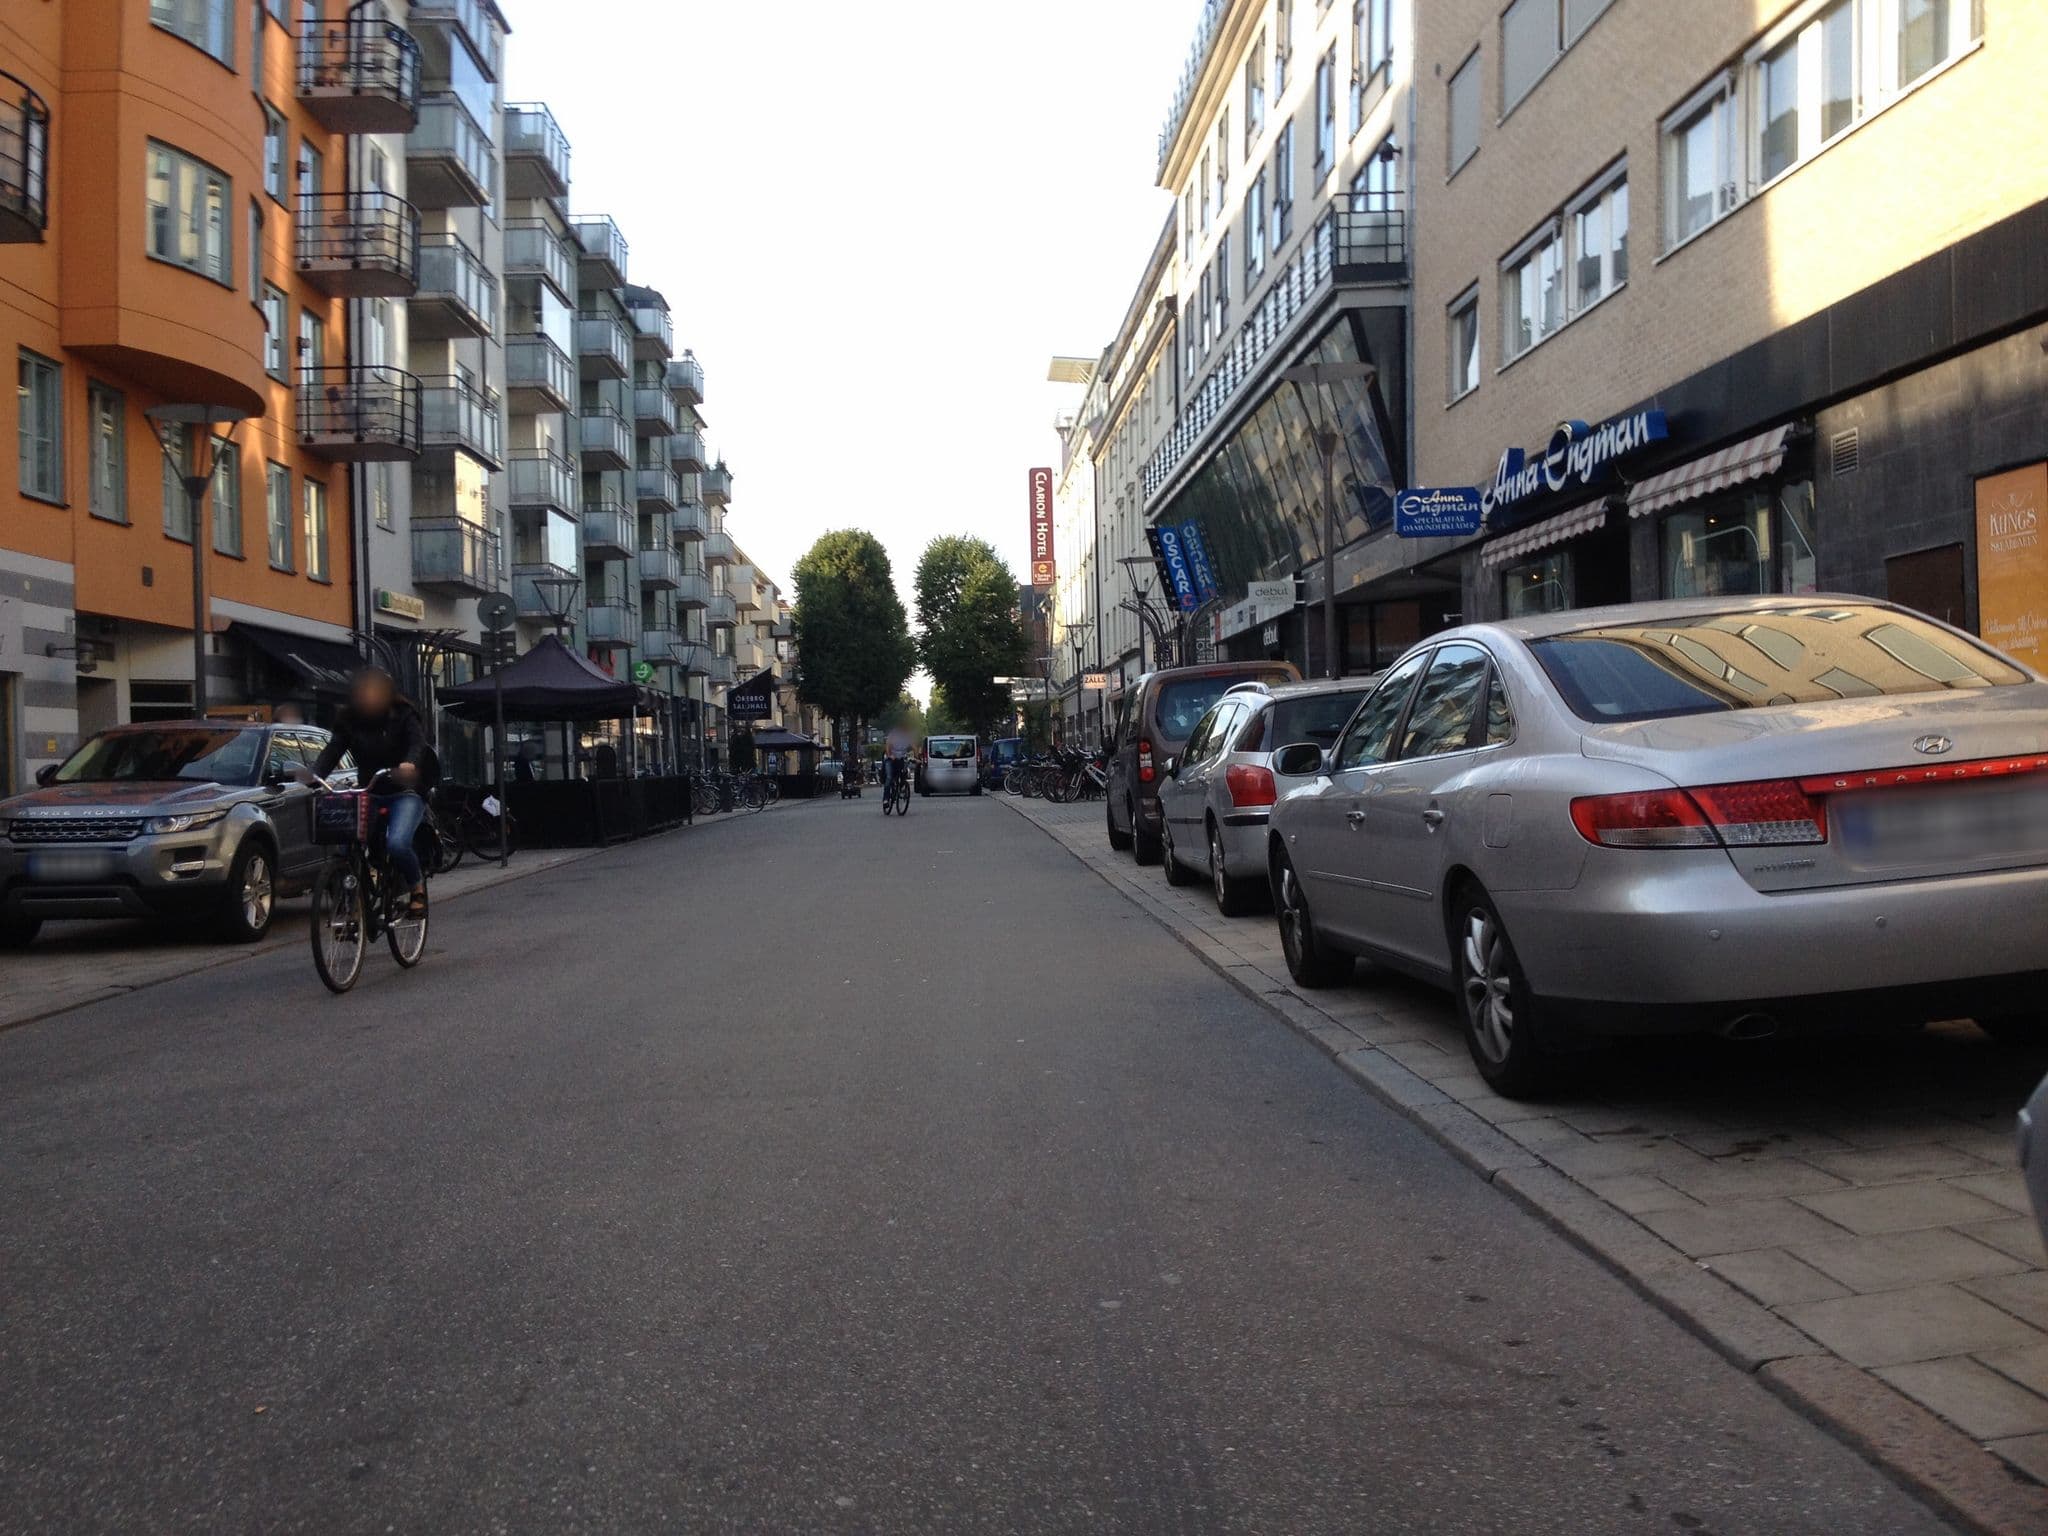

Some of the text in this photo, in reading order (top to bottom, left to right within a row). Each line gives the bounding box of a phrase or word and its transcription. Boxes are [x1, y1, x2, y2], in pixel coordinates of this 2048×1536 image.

[1481, 411, 1650, 514] Anna Engman
[1400, 496, 1478, 517] Engman
[1421, 489, 1464, 504] Anna
[1034, 471, 1048, 558] CLARION HOTEL
[1162, 532, 1190, 593] OSCAR
[1255, 587, 1289, 597] debut
[735, 694, 765, 702] ÖREBRO
